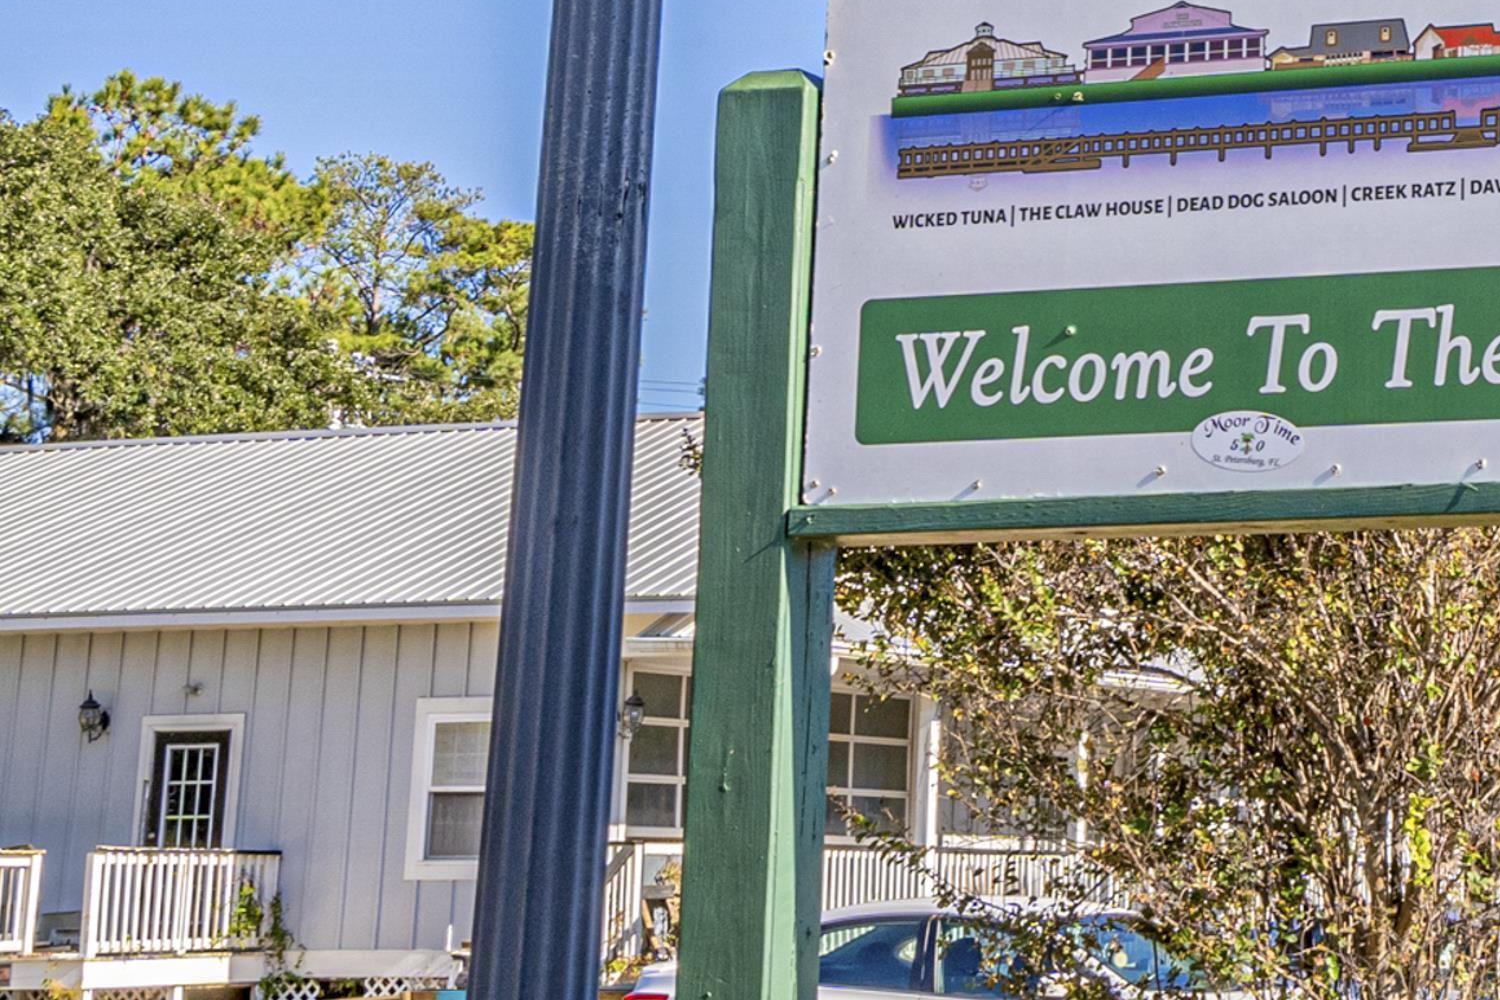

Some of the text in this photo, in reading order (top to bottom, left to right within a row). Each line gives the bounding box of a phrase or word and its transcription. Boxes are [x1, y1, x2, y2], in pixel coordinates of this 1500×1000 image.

[893, 211, 957, 229] WICKED
[961, 209, 1007, 225] TUNA
[1019, 206, 1052, 221] THE
[1055, 204, 1101, 219] CLAW
[1106, 199, 1164, 216] HOUSE
[1177, 196, 1223, 212] DEAD
[1228, 193, 1264, 209] DOG
[1268, 189, 1337, 207] SALOON
[1351, 184, 1407, 202] CREEK
[1411, 181, 1456, 199] RATZ
[895, 325, 1214, 410] Welcome
[1246, 313, 1338, 394] To
[1204, 415, 1301, 445] Moor Time
